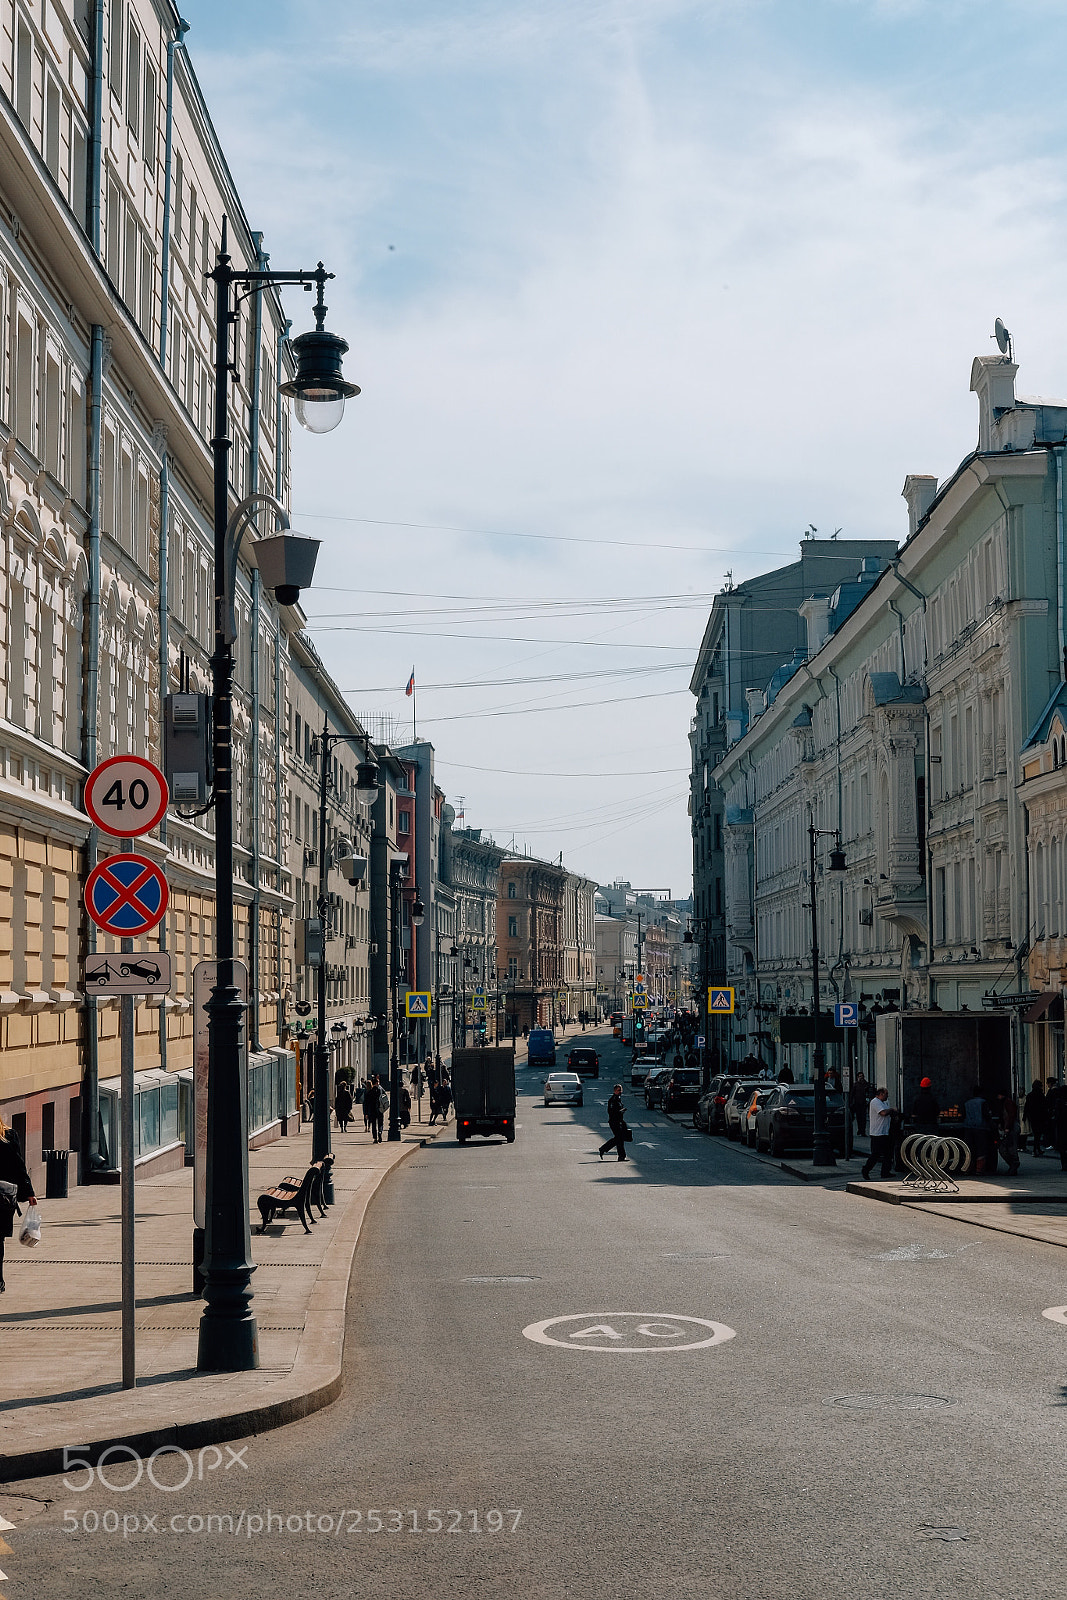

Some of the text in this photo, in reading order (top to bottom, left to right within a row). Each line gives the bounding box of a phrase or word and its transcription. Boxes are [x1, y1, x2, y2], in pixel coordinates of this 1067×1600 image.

[102, 779, 150, 811] 40
[840, 1004, 854, 1025] P
[697, 1036, 706, 1048] P
[569, 1324, 686, 1340] 40
